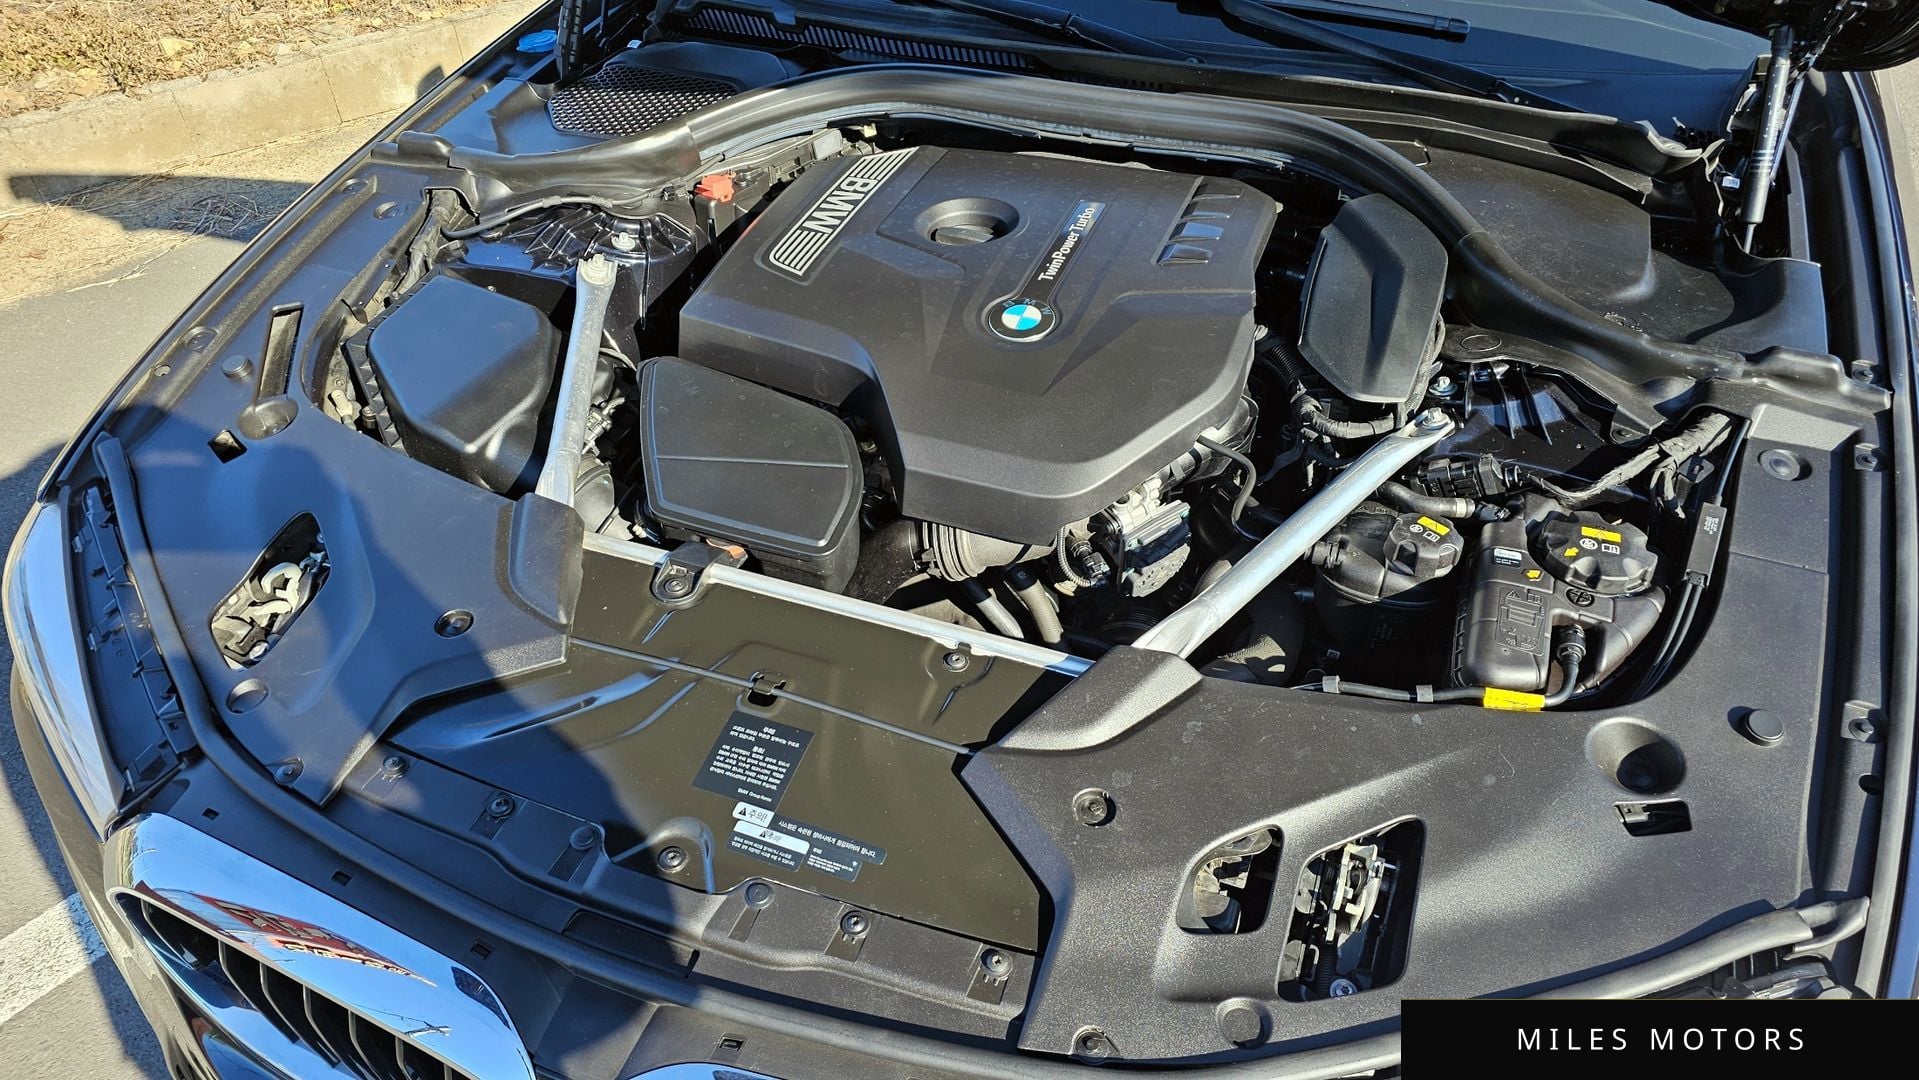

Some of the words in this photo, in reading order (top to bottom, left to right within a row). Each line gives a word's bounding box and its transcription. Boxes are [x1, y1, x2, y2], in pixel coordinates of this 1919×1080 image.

[802, 177, 879, 234] BMW
[1038, 231, 1080, 281] TwinPower
[1068, 207, 1095, 231] Turbo
[1002, 298, 1053, 315] BMW
[749, 809, 768, 823] 주의!
